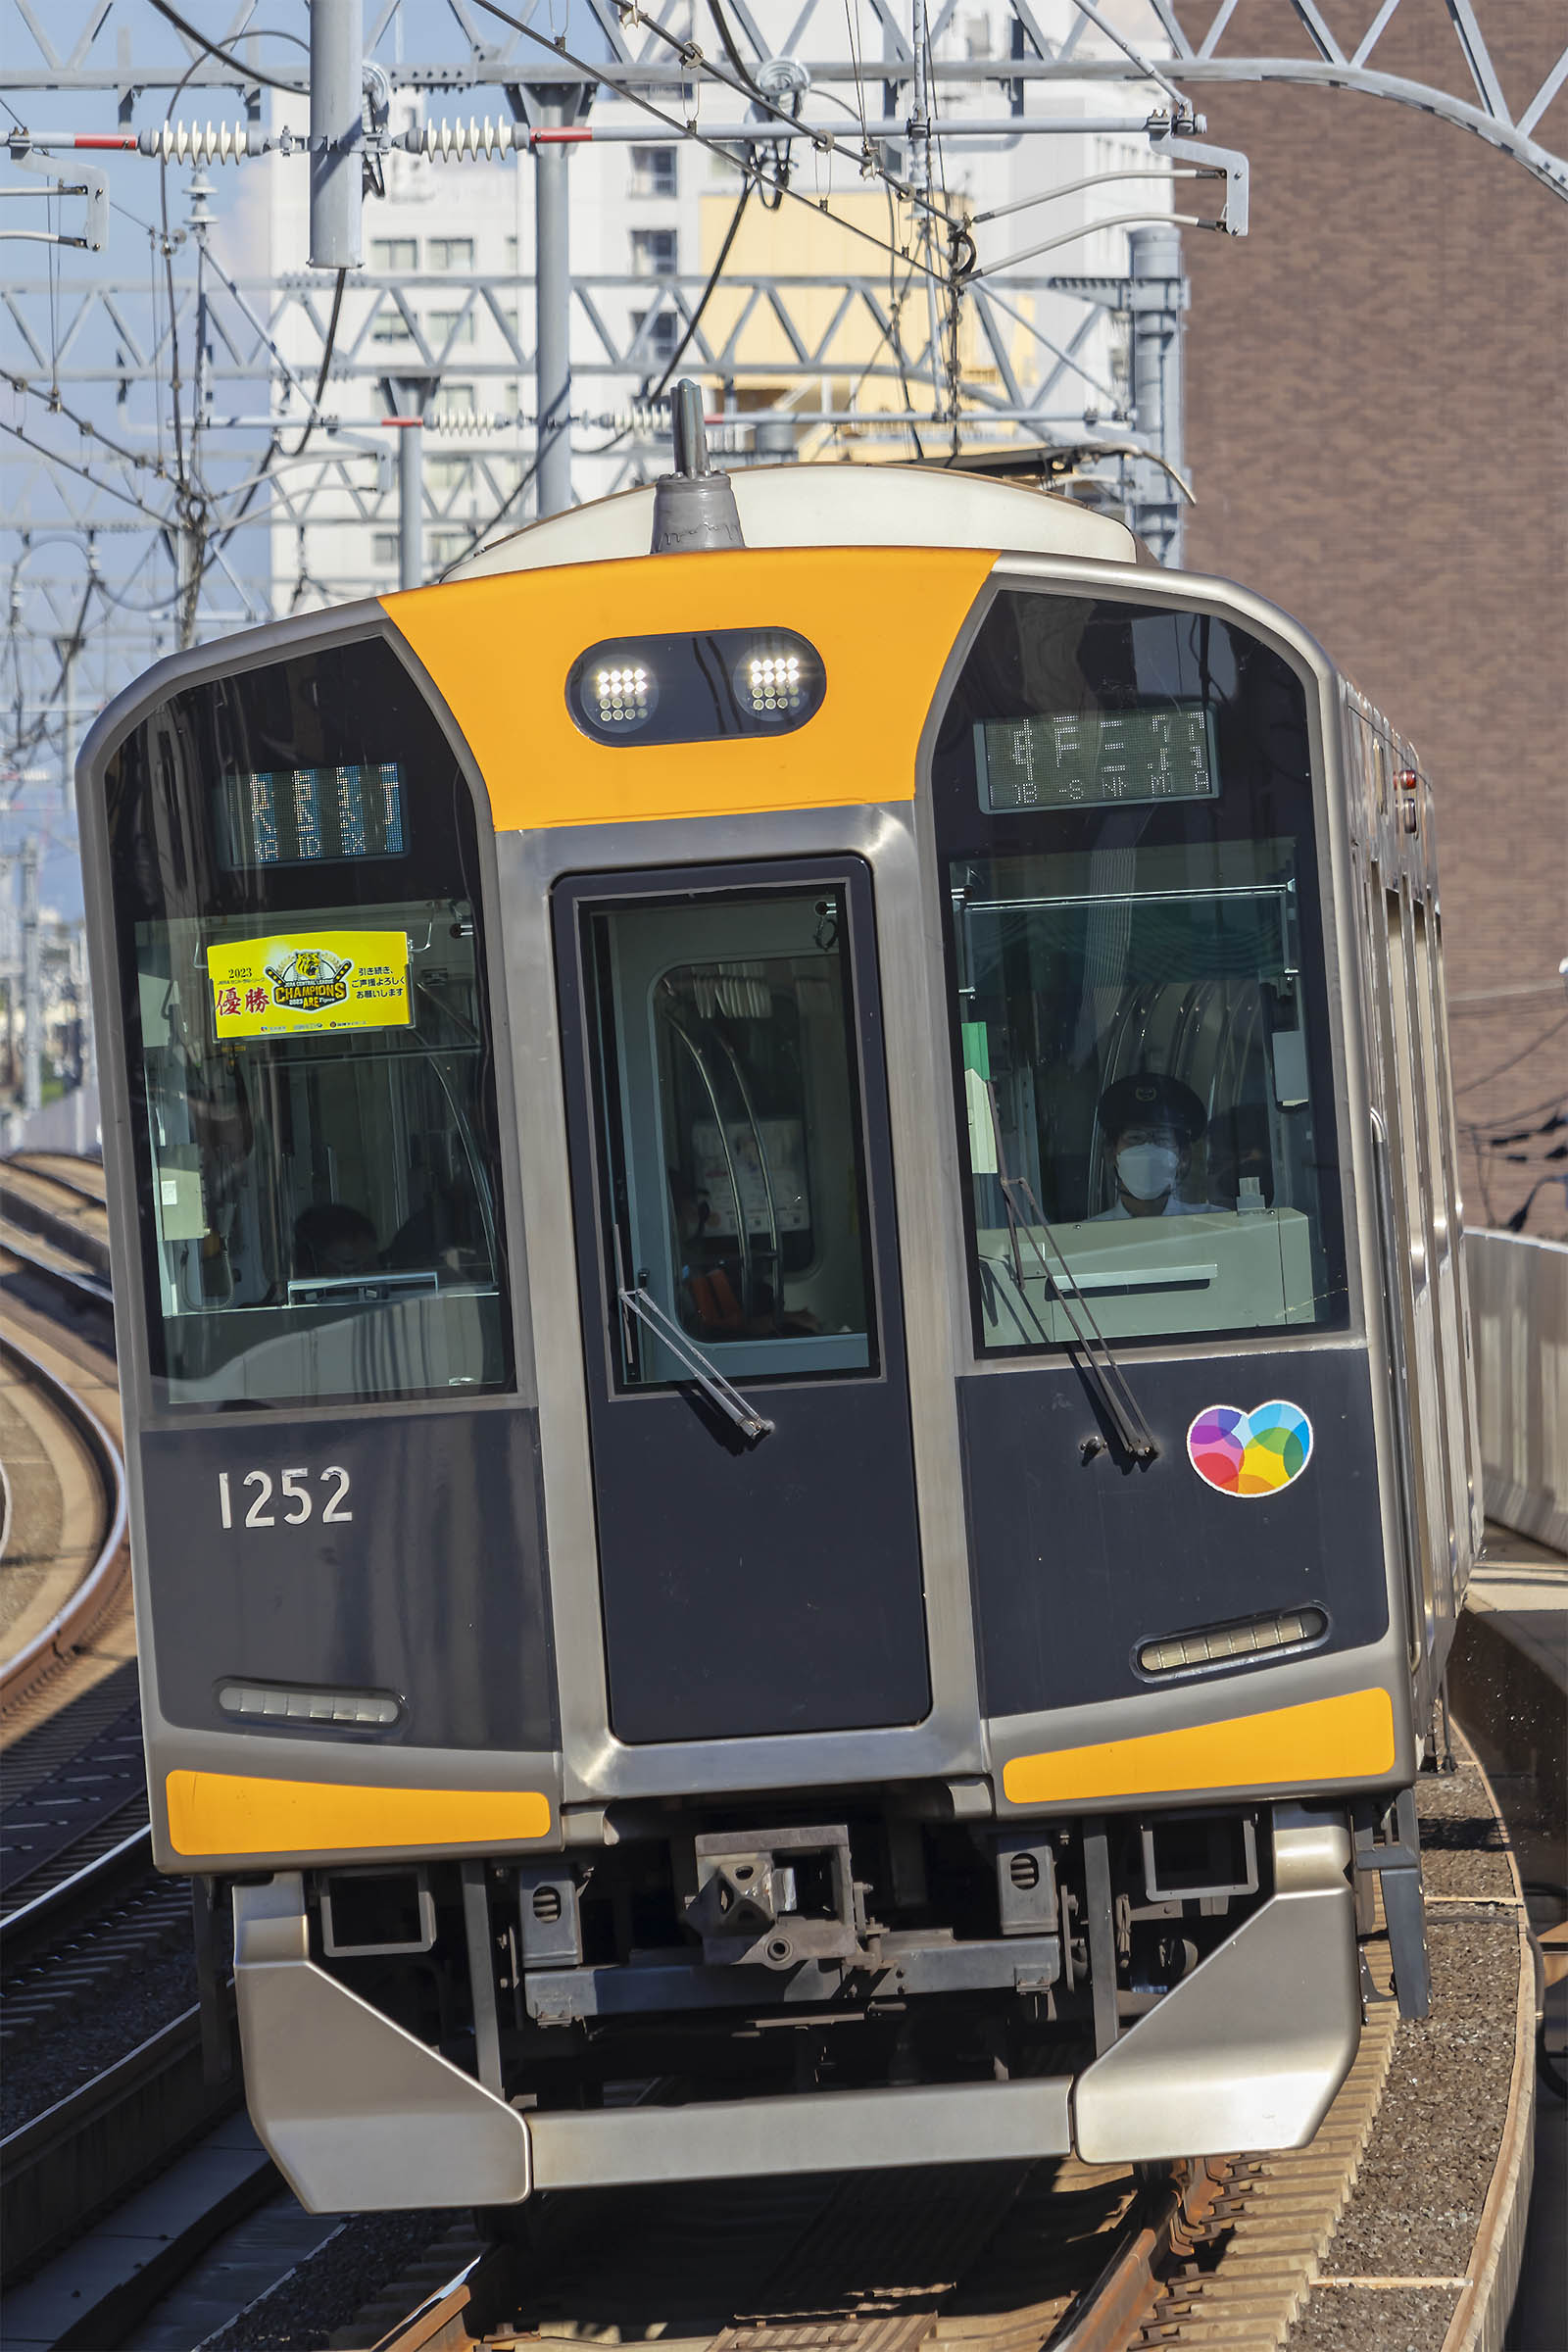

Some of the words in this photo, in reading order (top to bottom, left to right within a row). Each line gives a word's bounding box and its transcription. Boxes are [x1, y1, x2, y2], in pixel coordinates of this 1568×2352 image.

[228, 967, 252, 979] 2023
[352, 976, 405, 988] ご声援よろしく
[275, 982, 346, 1003] CHAMPIONS
[357, 988, 403, 999] お願いします
[217, 987, 270, 1016] 優勝
[303, 997, 319, 1008] ARE
[219, 1465, 353, 1529] 1252
